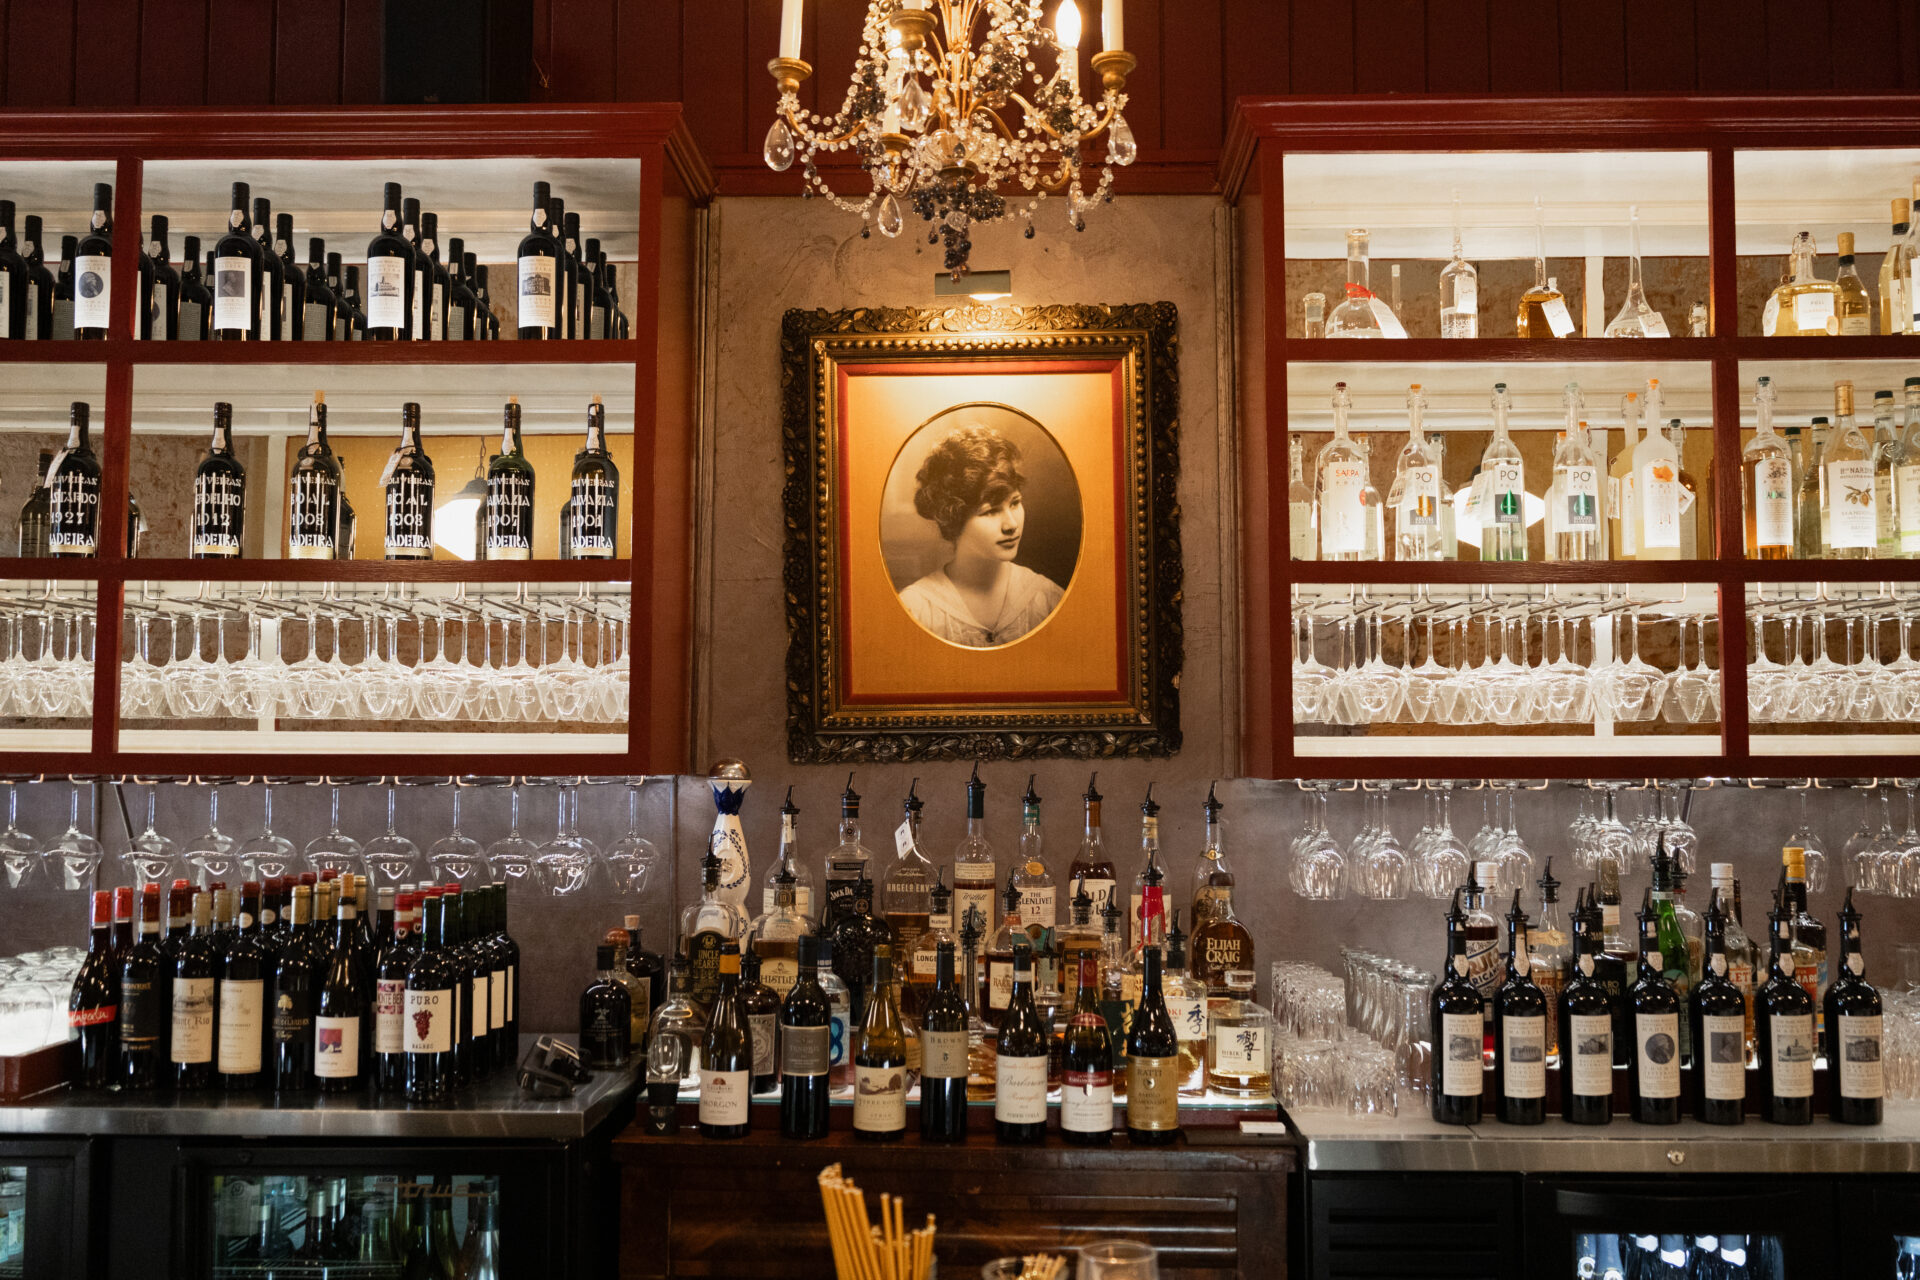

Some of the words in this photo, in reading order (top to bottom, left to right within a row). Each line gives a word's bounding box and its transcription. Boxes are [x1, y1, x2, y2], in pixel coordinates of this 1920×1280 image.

[487, 534, 529, 548] ADEIRA
[1031, 906, 1041, 915] 12
[1206, 938, 1241, 951] ELIJAH
[698, 949, 719, 959] UNCLE
[1206, 950, 1241, 964] CRAIG
[410, 995, 440, 1005] PURO
